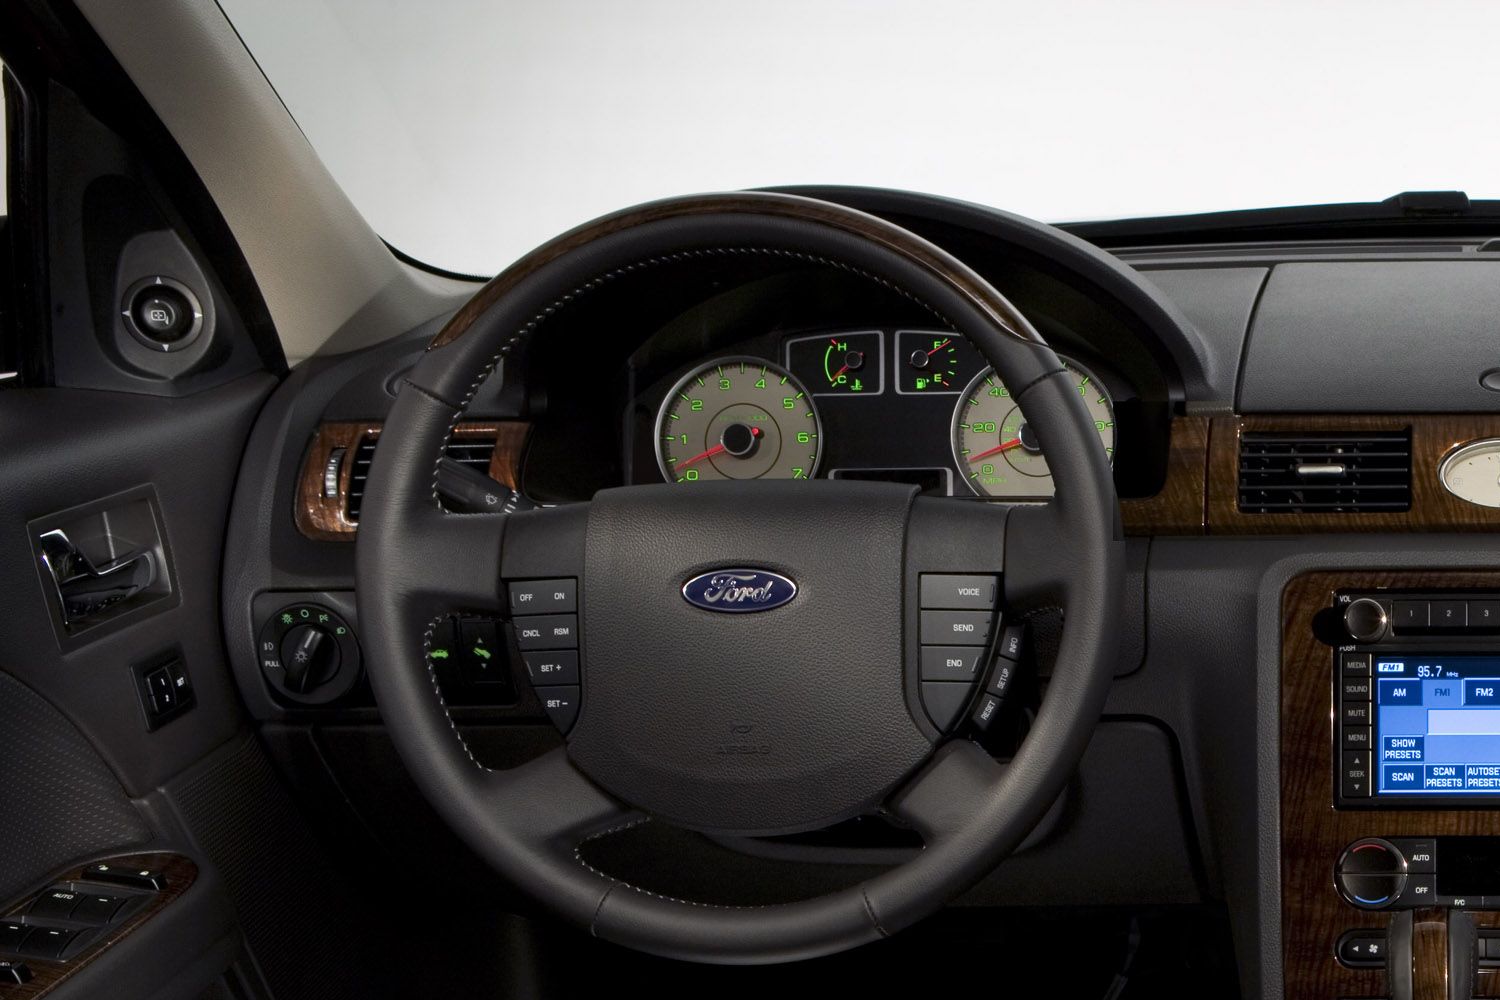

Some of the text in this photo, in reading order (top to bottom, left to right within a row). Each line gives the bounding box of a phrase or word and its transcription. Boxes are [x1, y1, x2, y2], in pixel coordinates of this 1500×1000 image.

[837, 343, 847, 351] H
[934, 341, 941, 349] F
[837, 375, 847, 384] C
[934, 374, 942, 382] E
[720, 380, 730, 389] 3
[755, 379, 766, 389] 4
[691, 400, 703, 411] 2
[783, 398, 794, 409] 5
[972, 422, 995, 432] 20
[681, 434, 687, 444] 1
[797, 433, 809, 443] 6
[982, 464, 993, 474] 0
[686, 470, 699, 480] 0
[792, 468, 802, 479] 7
[704, 574, 774, 602] Ford
[958, 588, 980, 596] VOICE
[520, 594, 533, 602] OFF
[554, 592, 565, 600] ON
[554, 628, 569, 636] RSM
[953, 624, 974, 632] SEND
[522, 630, 540, 638] CNCL
[1008, 637, 1018, 654] INFO
[264, 660, 280, 668] PULL
[946, 659, 962, 667] END
[1347, 661, 1366, 669] MEDIA
[540, 664, 554, 672] SET
[1417, 666, 1442, 678] 95.7
[996, 668, 1010, 690] SETUP
[1393, 688, 1406, 696] AM
[1434, 688, 1450, 696] FM1
[1475, 688, 1494, 696] FM2
[546, 700, 560, 708] SET
[980, 700, 996, 721] RESET
[1391, 739, 1416, 748] SHOW
[1385, 750, 1421, 758] PRESETS
[1349, 770, 1364, 778] SEEK
[1433, 767, 1456, 776] SCAN
[1392, 773, 1414, 781] SCAN
[1426, 778, 1462, 787] PRESETS
